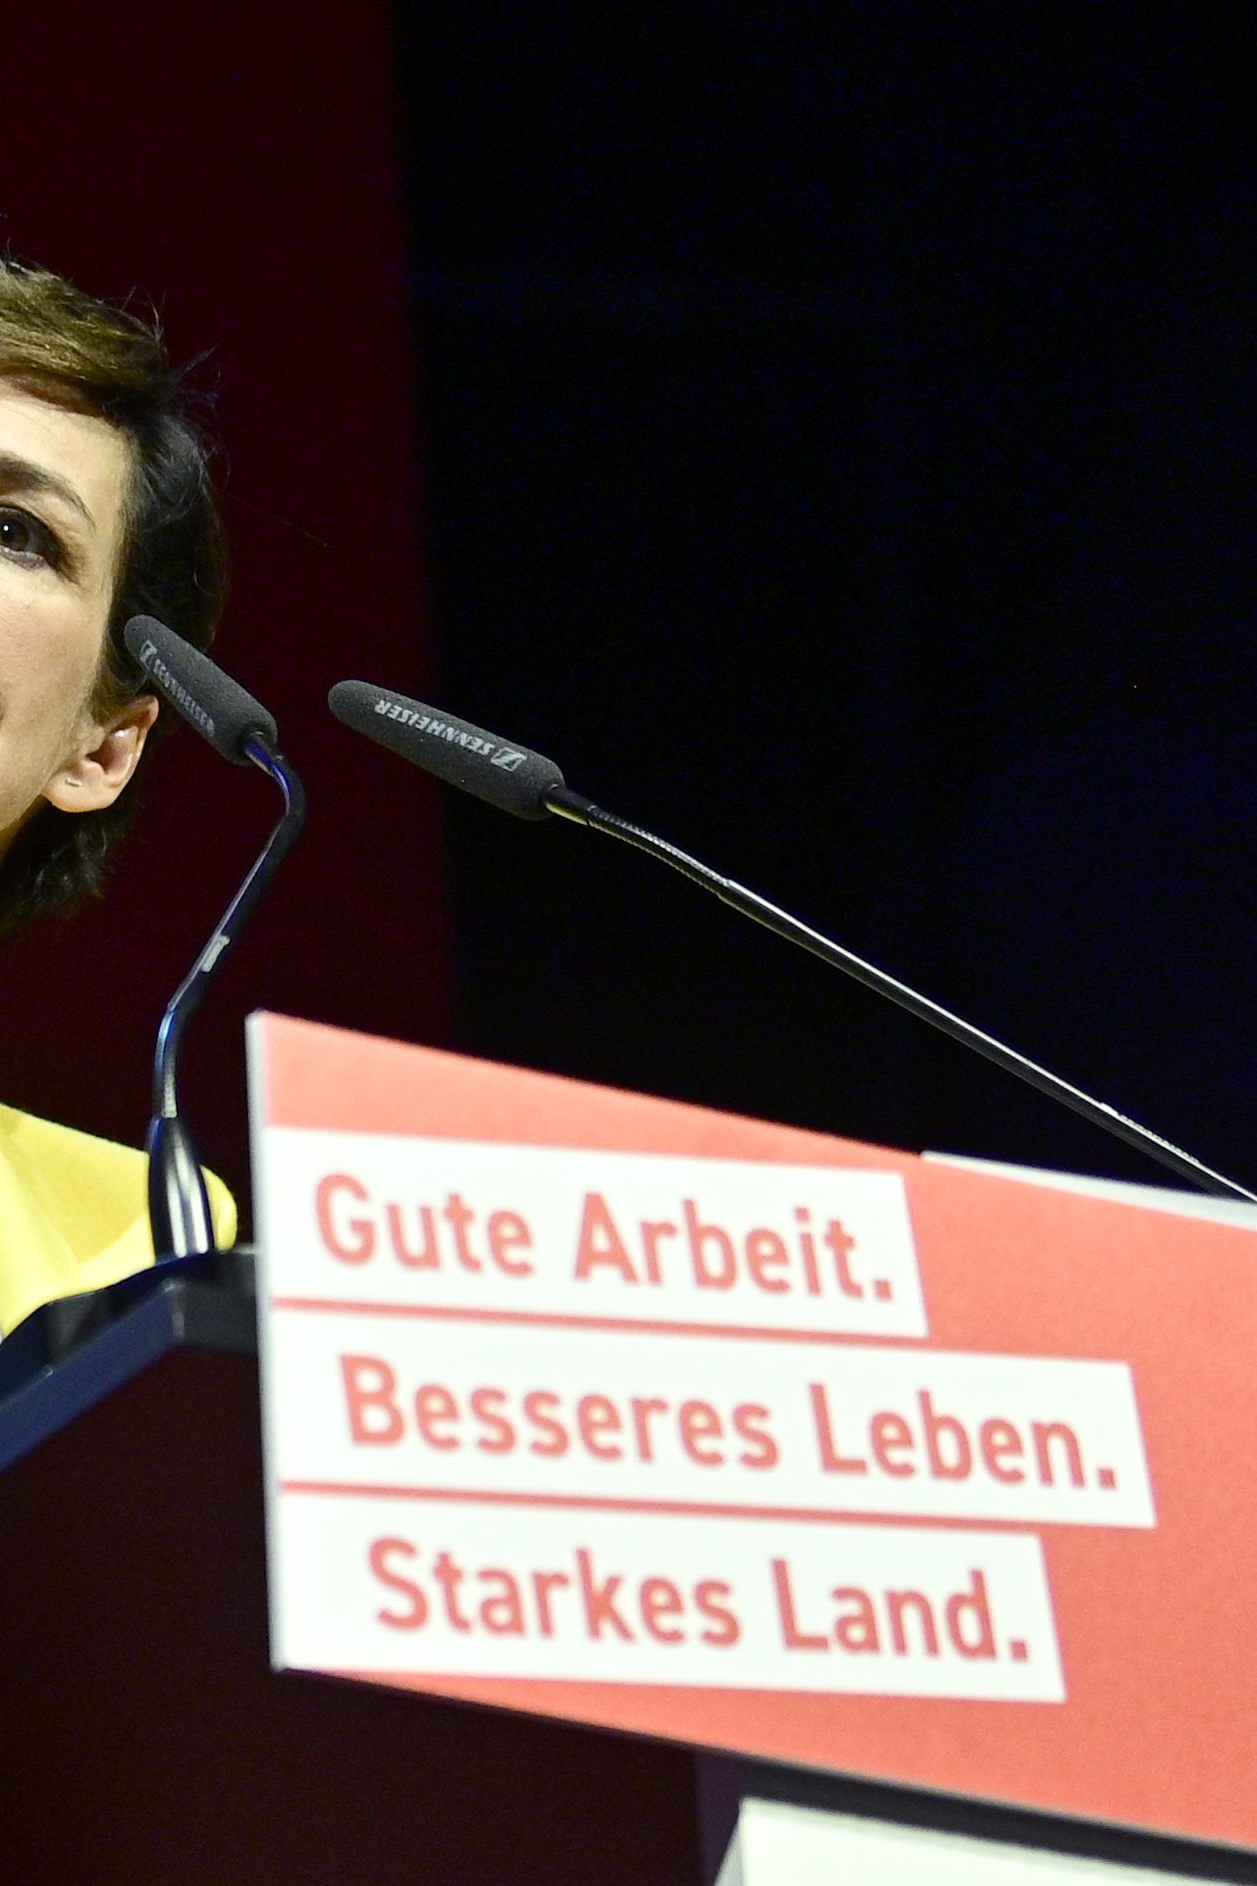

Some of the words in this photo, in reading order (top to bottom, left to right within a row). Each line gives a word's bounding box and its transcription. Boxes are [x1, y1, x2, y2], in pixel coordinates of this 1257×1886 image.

[374, 699, 496, 756] SENNHEISER
[317, 1174, 532, 1275] Gute
[574, 1194, 892, 1300] Arbeit.
[340, 1354, 780, 1469] Besseres
[810, 1384, 1116, 1489] Leben.
[368, 1537, 741, 1647] Starkes
[773, 1559, 1030, 1662] Land.
